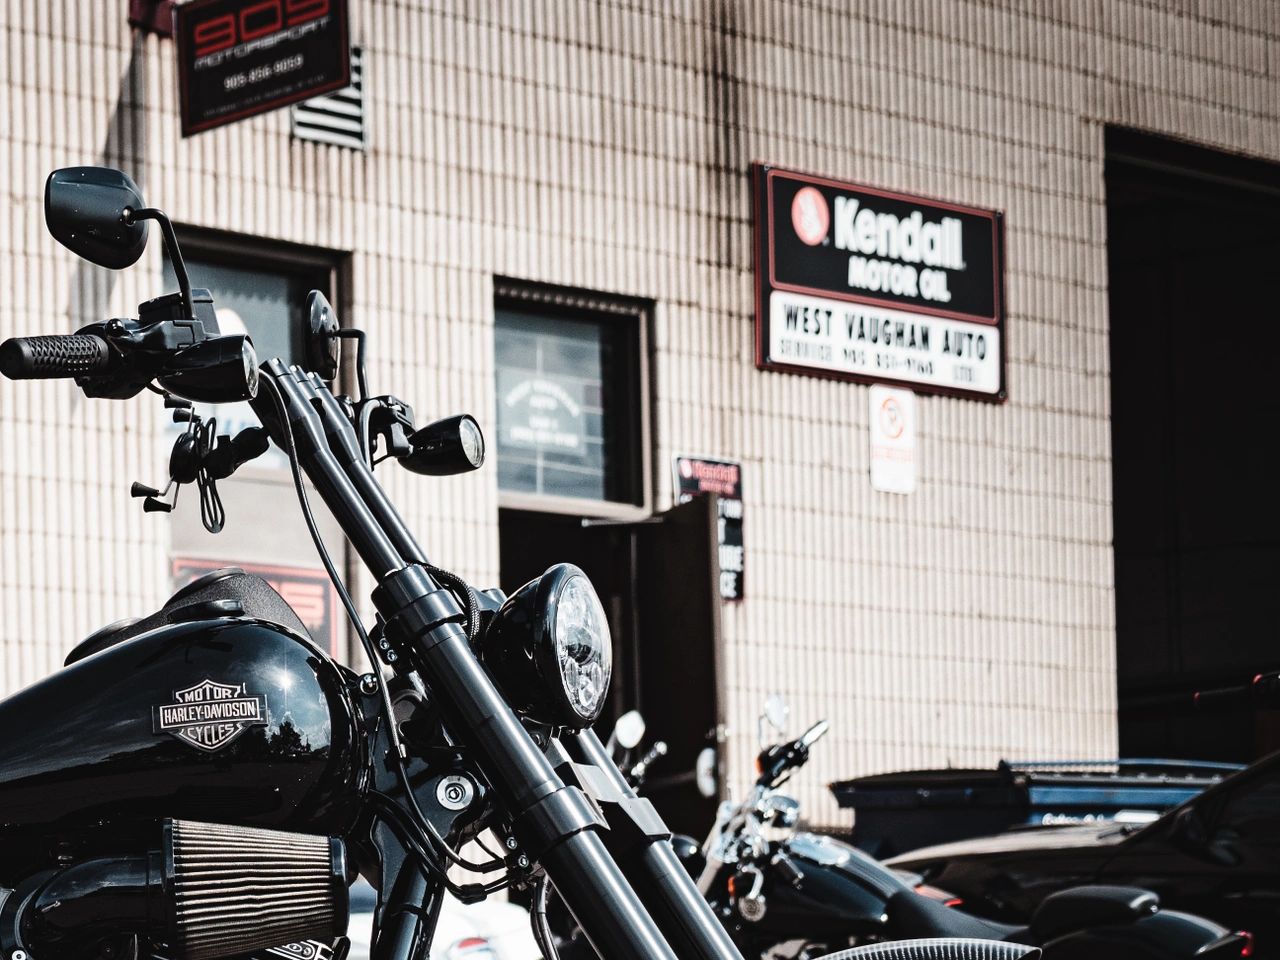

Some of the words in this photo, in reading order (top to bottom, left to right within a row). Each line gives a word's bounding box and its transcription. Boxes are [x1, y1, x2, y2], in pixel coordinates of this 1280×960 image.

[833, 196, 963, 270] Kendall
[847, 255, 918, 297] MOTOR
[920, 268, 952, 302] OIL
[783, 303, 833, 337] WEST
[845, 311, 930, 351] VAUGHAN
[942, 330, 986, 360] AUTO
[184, 684, 233, 703] MOTOR
[164, 700, 256, 725] HARLEY-DAVIDSON
[187, 722, 234, 745] CYCLES
